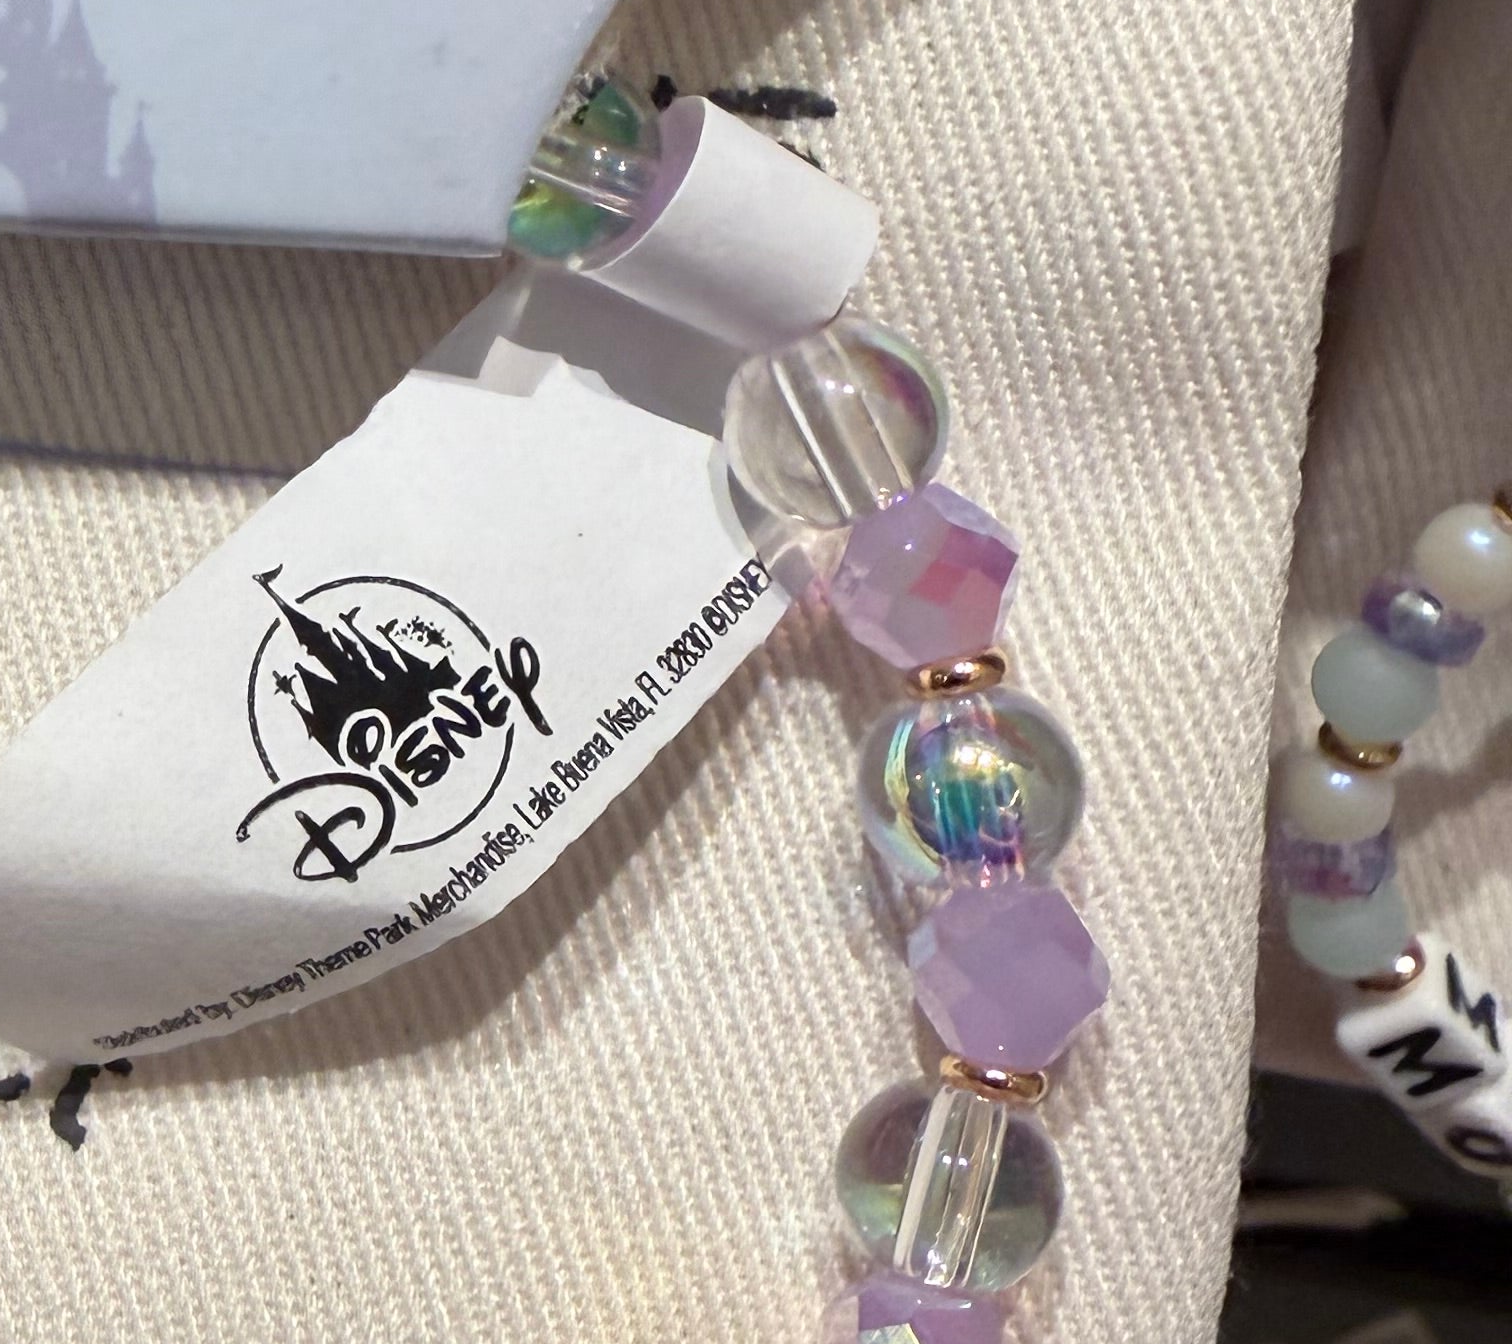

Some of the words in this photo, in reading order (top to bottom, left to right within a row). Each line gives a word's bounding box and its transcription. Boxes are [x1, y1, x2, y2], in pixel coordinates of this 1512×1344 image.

[295, 939, 373, 981] Theme
[363, 913, 420, 951] Park
[408, 822, 535, 928] Merchandise,
[512, 781, 567, 830] Lake
[550, 731, 615, 793] Buena
